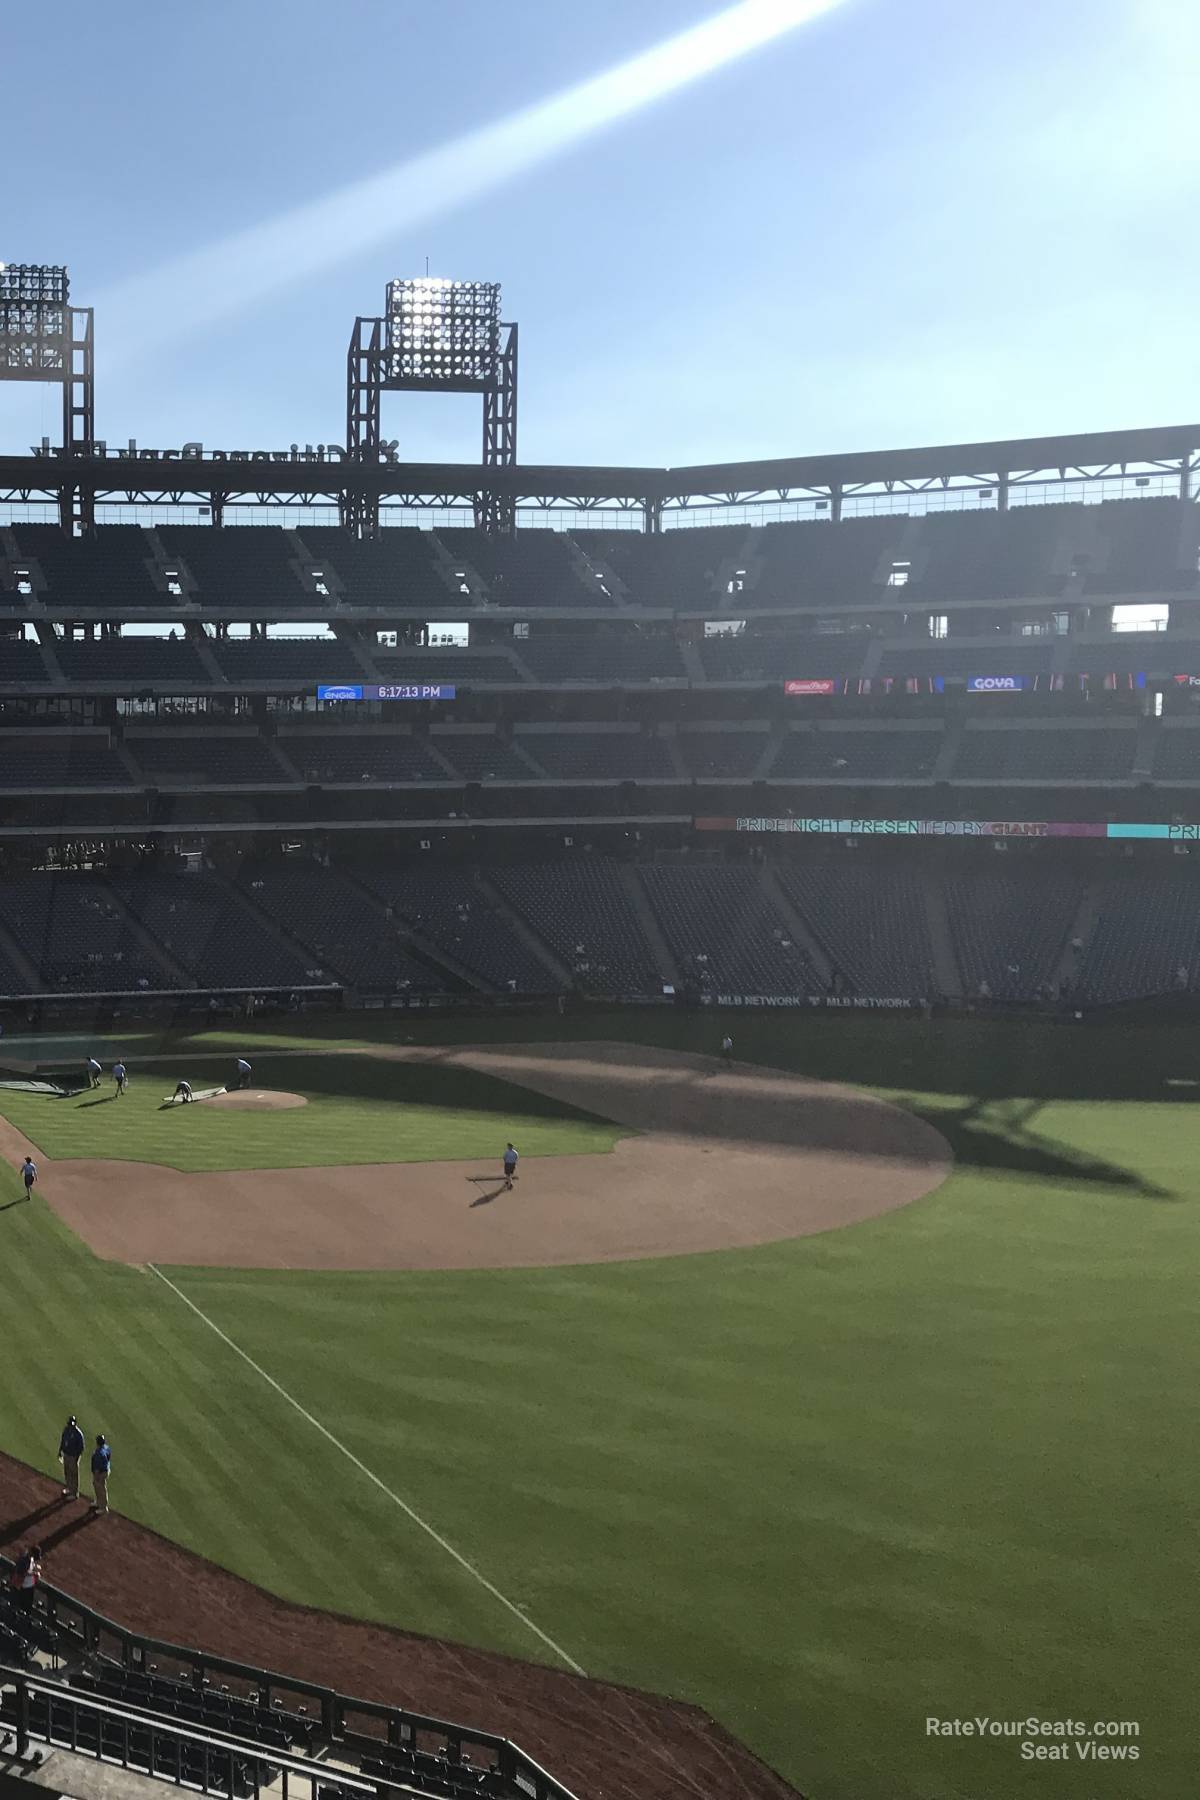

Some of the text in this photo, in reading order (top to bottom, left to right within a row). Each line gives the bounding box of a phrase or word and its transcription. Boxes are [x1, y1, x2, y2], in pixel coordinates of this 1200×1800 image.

[378, 686, 440, 697] 6:17:13 PM
[736, 817, 1047, 836] PRIDE NIGHT PRESENTED BY GIANT
[718, 995, 800, 1006] MLB NETWORK
[826, 997, 911, 1008] MLB NETWORK
